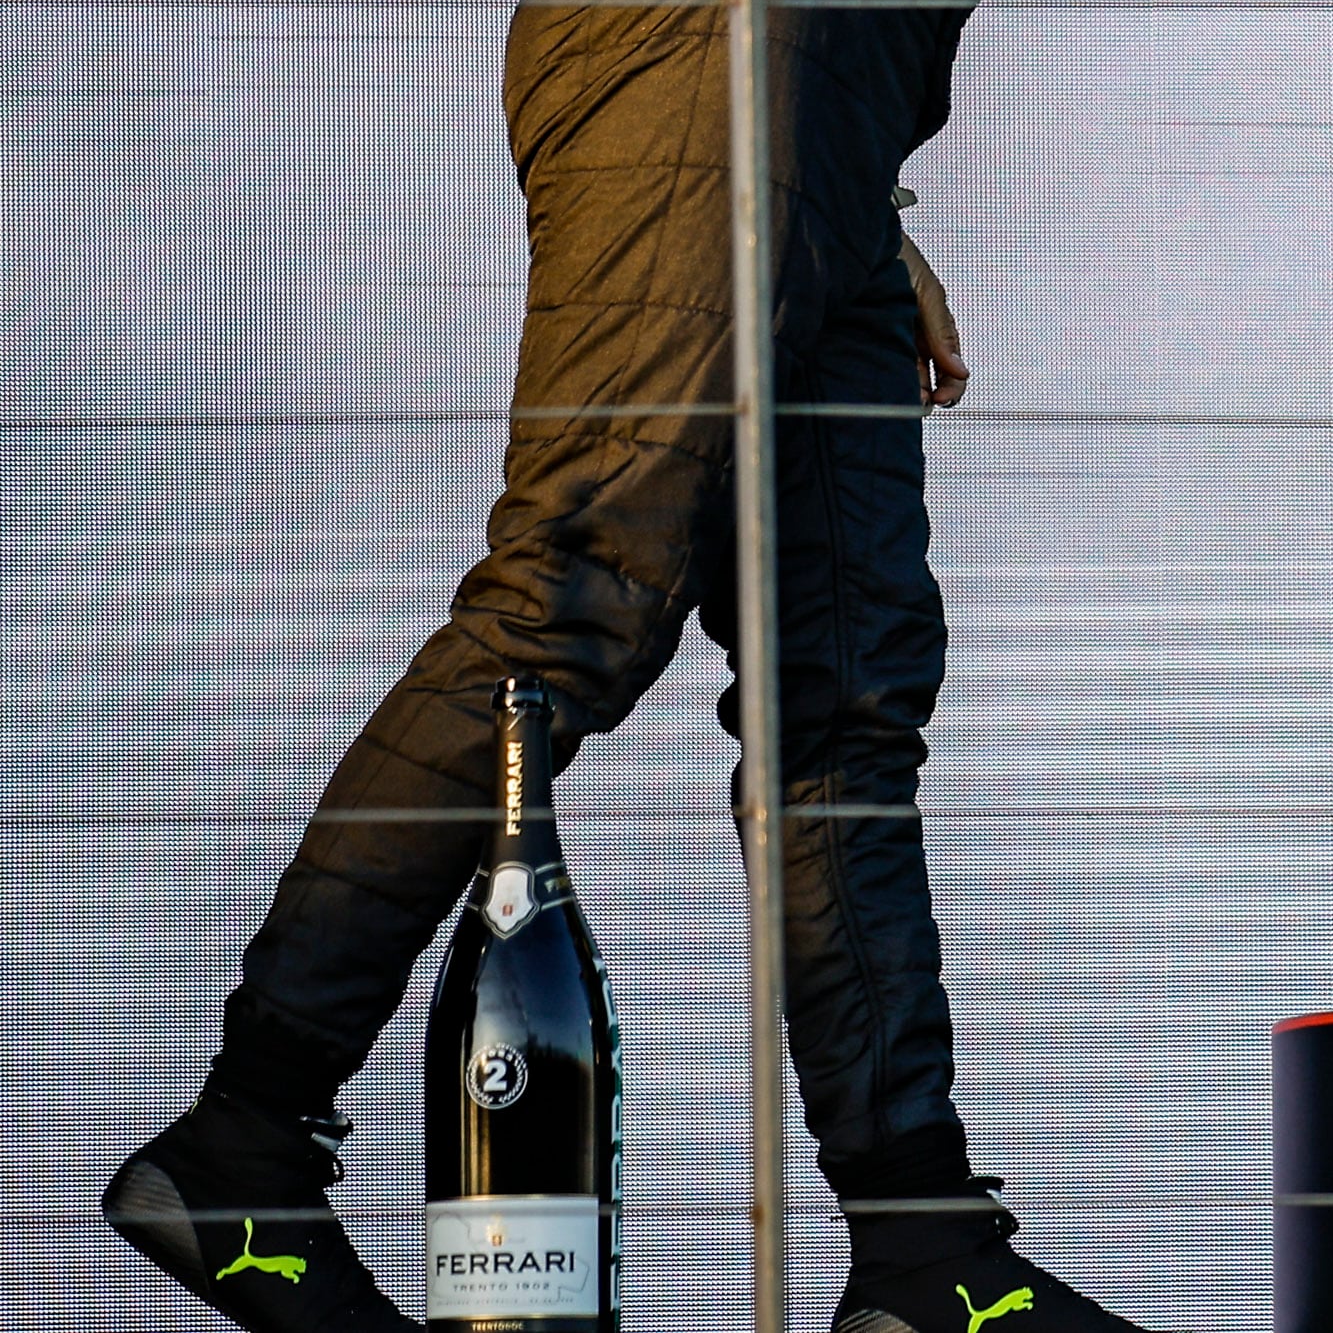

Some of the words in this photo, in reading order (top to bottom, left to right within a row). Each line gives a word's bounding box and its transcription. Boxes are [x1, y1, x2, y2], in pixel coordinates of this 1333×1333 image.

[506, 741, 523, 837] FERRARI
[483, 1060, 507, 1092] 2
[436, 1251, 575, 1277] FERRARI
[453, 1280, 508, 1293] TRENTO
